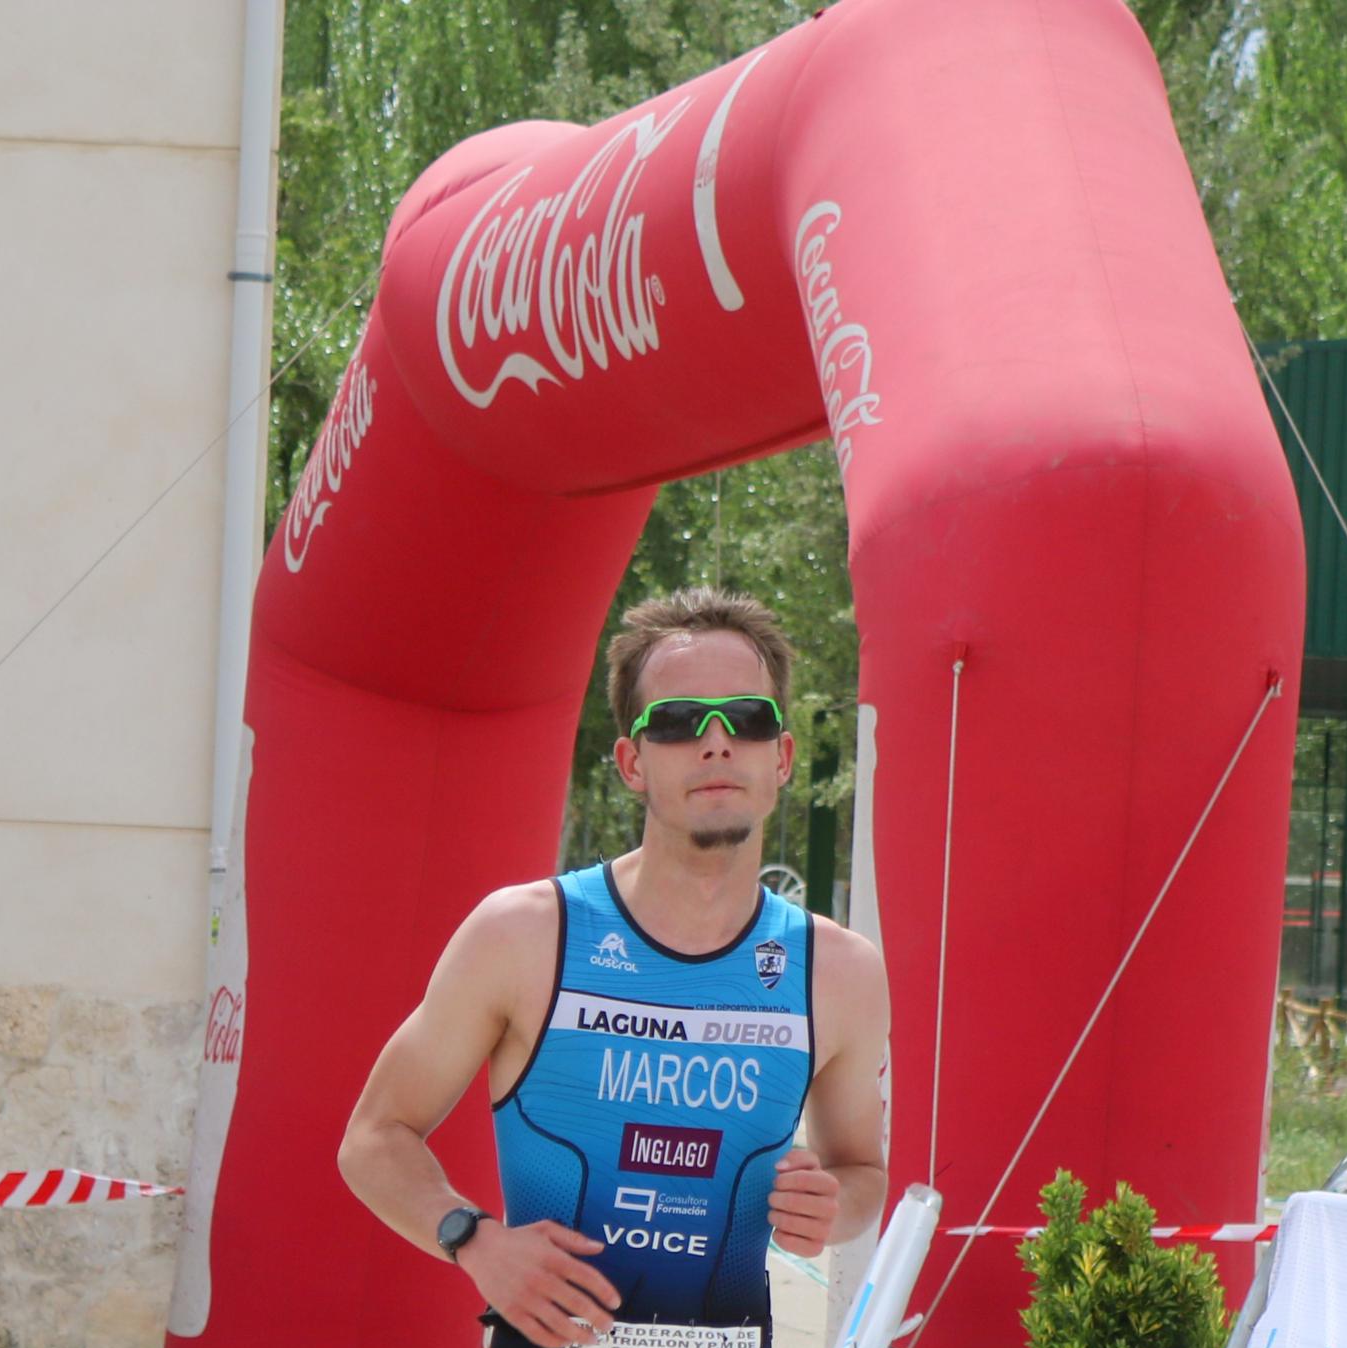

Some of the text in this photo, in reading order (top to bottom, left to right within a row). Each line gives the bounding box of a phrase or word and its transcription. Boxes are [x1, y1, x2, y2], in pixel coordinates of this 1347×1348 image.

[436, 95, 695, 410] Coca-Cola
[577, 1007, 688, 1041] LAGUNA
[597, 1048, 761, 1112] MARCOS
[655, 1203, 707, 1217] Formación
[658, 1193, 708, 1207] Consultora
[602, 1224, 708, 1256] VOICE
[612, 1336, 689, 1348] TRIATLON
[737, 1331, 755, 1341] DE
